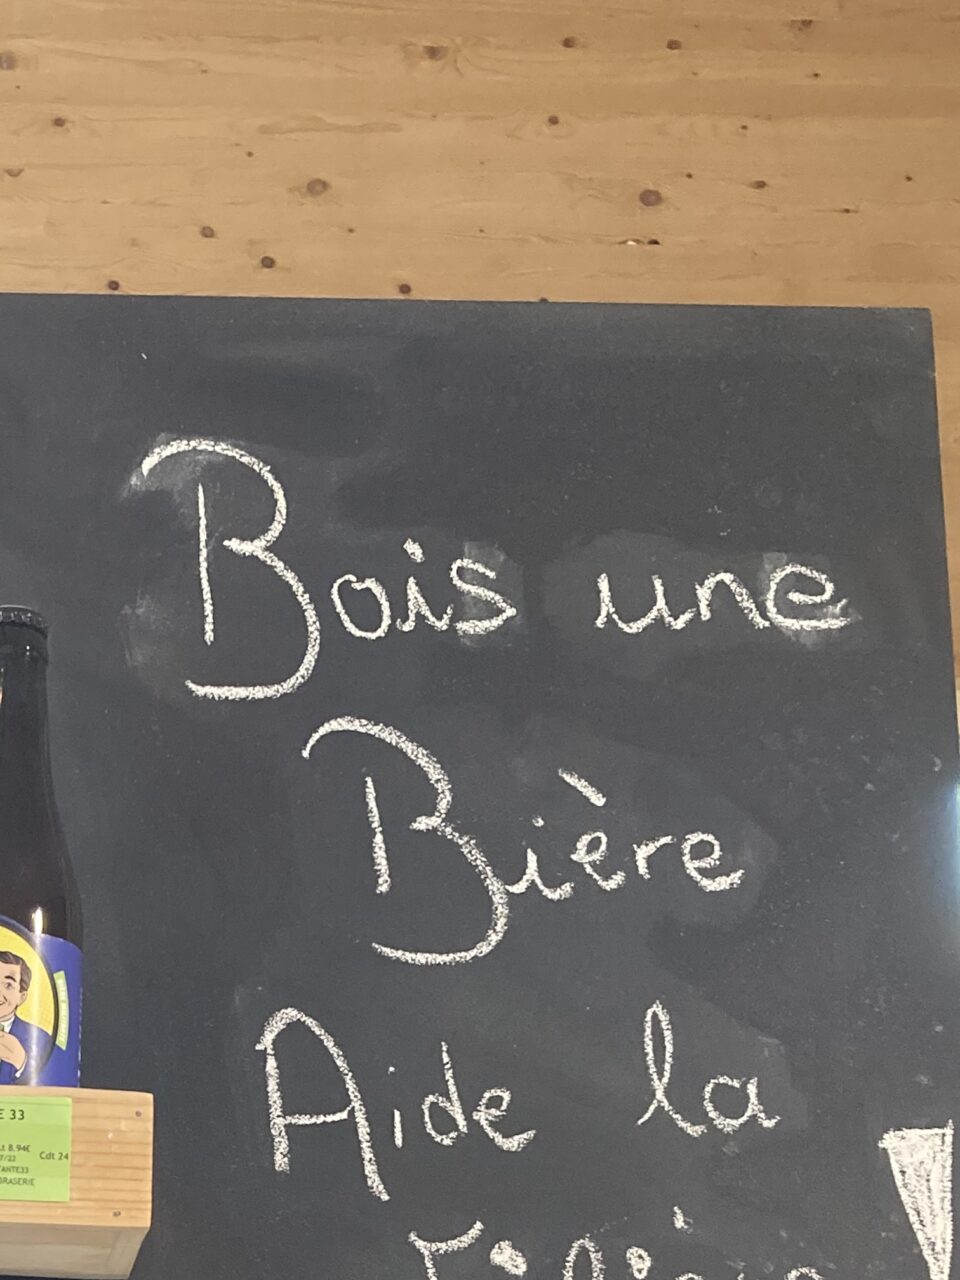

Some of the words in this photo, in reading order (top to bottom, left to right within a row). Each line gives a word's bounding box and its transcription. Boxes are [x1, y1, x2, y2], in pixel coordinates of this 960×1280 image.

[142, 438, 517, 699] Bois
[594, 562, 848, 633] une
[302, 715, 743, 966] Bière
[8, 1144, 31, 1152] 8.94€
[10, 1110, 25, 1120] 33
[256, 1006, 536, 1201] Aide
[637, 1000, 781, 1137] la
[40, 1152, 55, 1160] Cdt
[58, 1152, 69, 1160] 24
